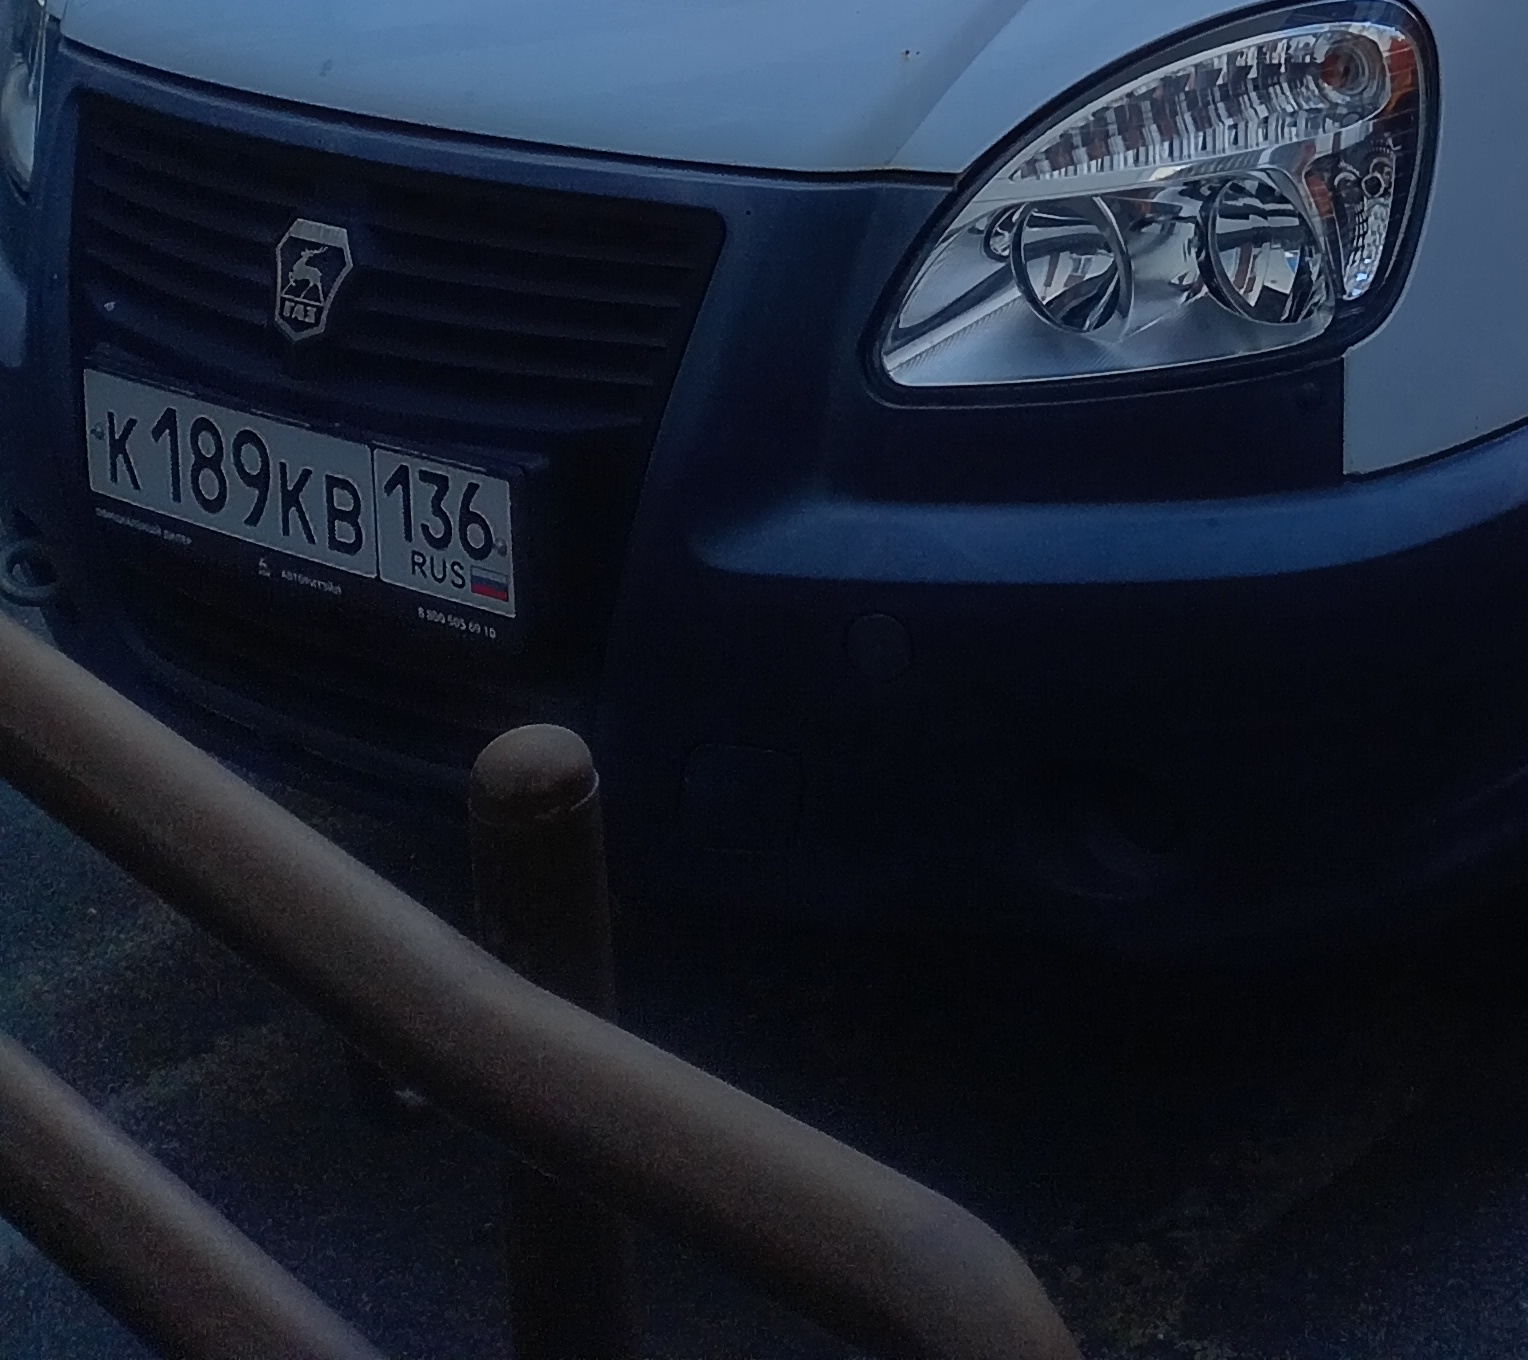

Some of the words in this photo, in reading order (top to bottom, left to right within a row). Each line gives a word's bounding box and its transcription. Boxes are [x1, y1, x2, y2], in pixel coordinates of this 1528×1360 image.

[282, 300, 318, 324] ГАЗ
[383, 463, 494, 561] 136
[410, 549, 466, 589] RUS
